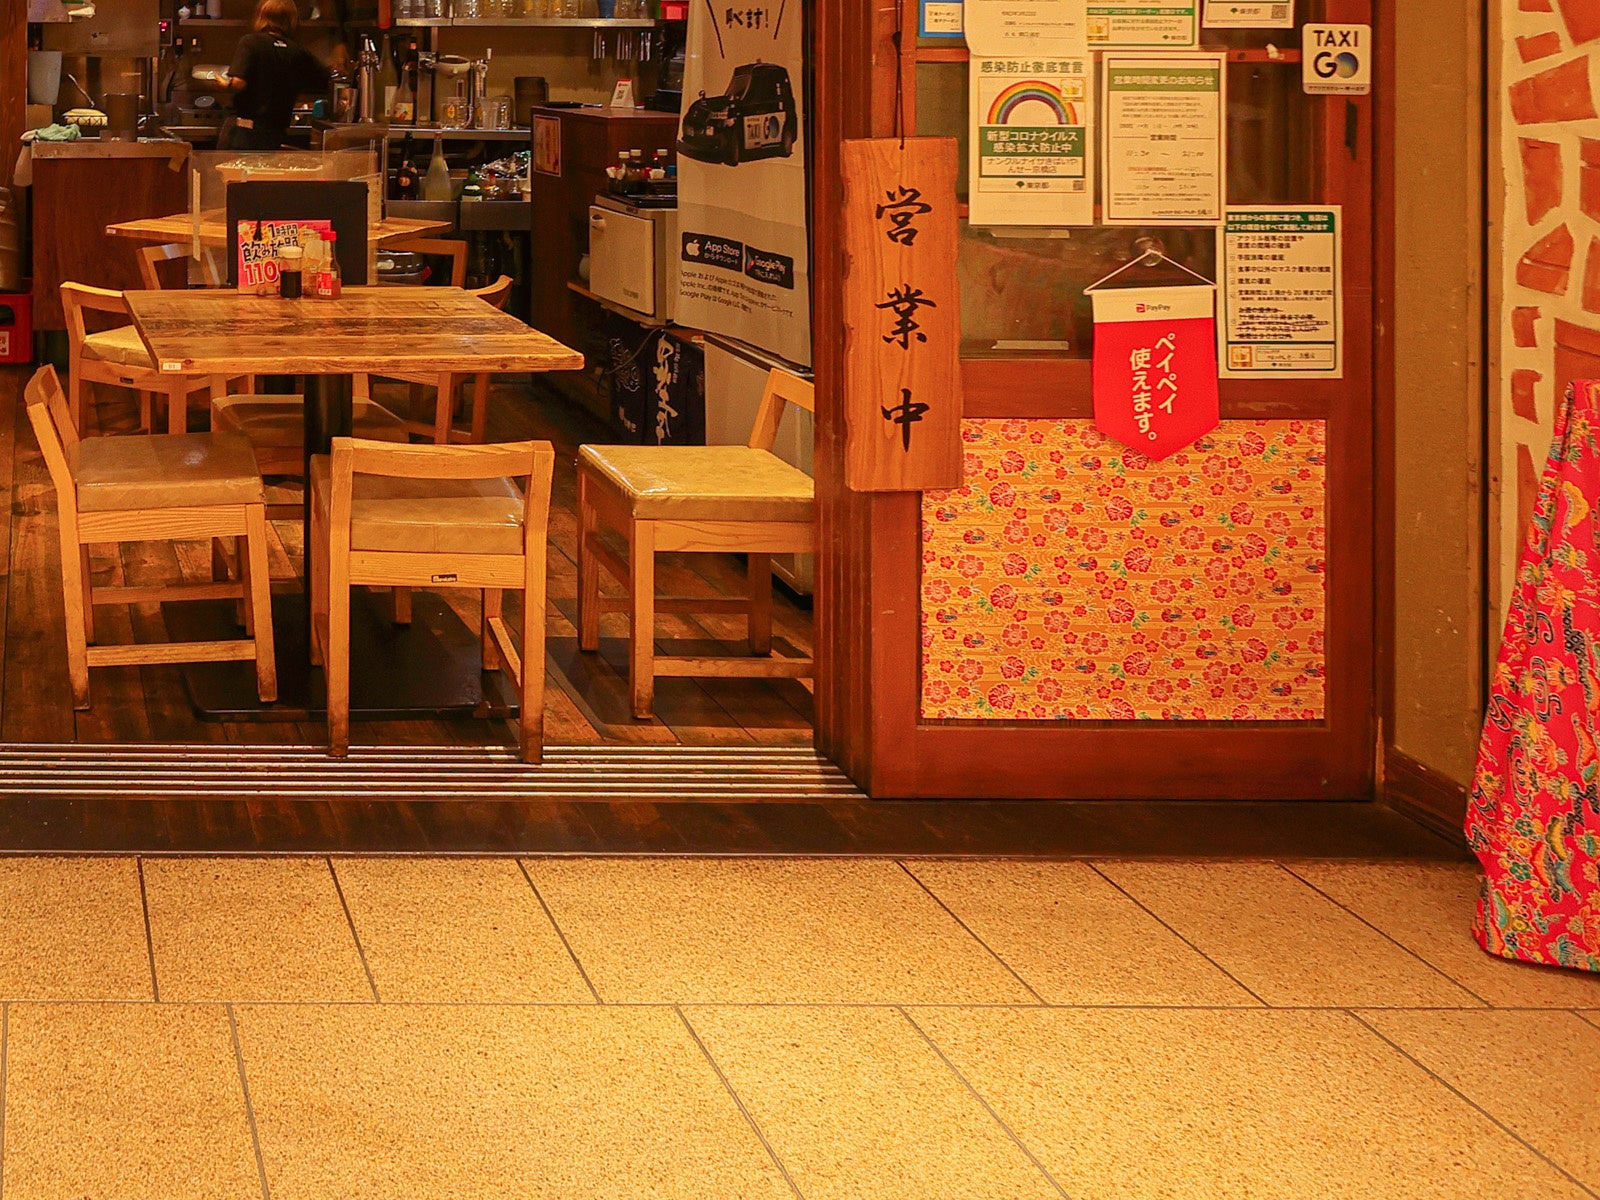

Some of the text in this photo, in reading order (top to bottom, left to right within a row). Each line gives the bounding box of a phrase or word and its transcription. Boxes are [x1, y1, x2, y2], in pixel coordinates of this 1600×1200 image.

[1313, 30, 1359, 48] TAXI
[980, 61, 1084, 74] 感染防止徹底宣言
[1113, 75, 1215, 86] 営業時間変更のお知らせ
[986, 130, 1079, 142] 新型コロナウイルス
[992, 143, 1073, 154] 感染拡大防止中
[267, 223, 298, 238] 1時間
[704, 241, 740, 257] App Store
[244, 260, 282, 285] 110
[1146, 303, 1171, 313] PayPay
[875, 185, 938, 453] 営業中
[1155, 332, 1178, 414] ペイペイ
[1129, 347, 1157, 441] 使えます。
